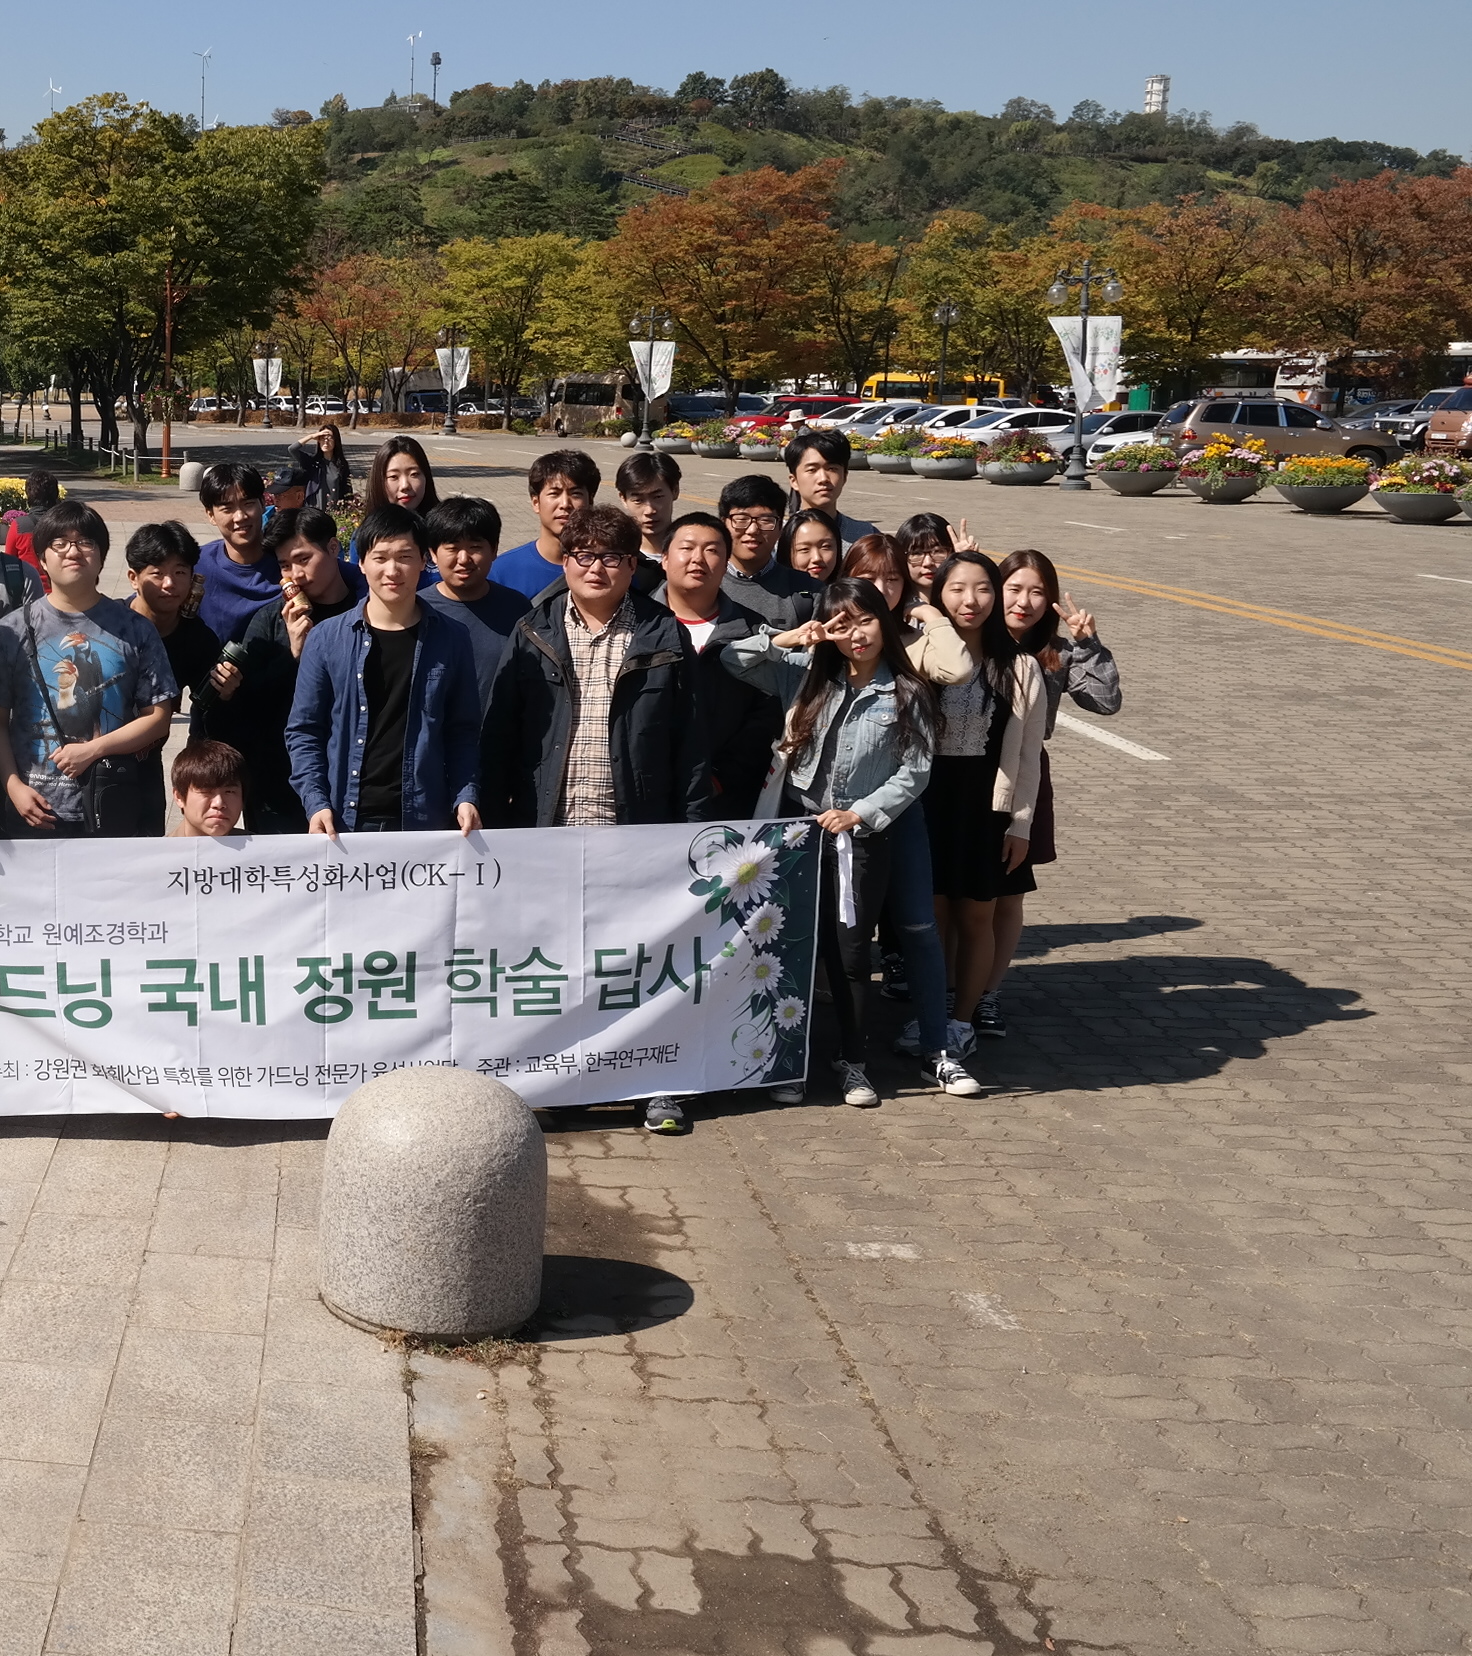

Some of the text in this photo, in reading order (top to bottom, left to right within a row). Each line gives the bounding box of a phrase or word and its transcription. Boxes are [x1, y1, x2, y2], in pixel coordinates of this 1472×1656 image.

[42, 920, 169, 946] 원예조경학과
[139, 954, 267, 1027] 국내
[293, 949, 418, 1024] 정원
[444, 946, 569, 1018] 학술
[593, 936, 712, 1011] 답사
[34, 1058, 87, 1081] 강원권
[162, 1067, 213, 1088] 특화를
[217, 1066, 252, 1088] 위한
[257, 1064, 309, 1087] 가드닝
[314, 1062, 368, 1085] 전문가
[476, 1057, 511, 1077] 주관
[524, 1053, 581, 1076] 교육부,
[584, 1042, 680, 1073] 한국연구재단
